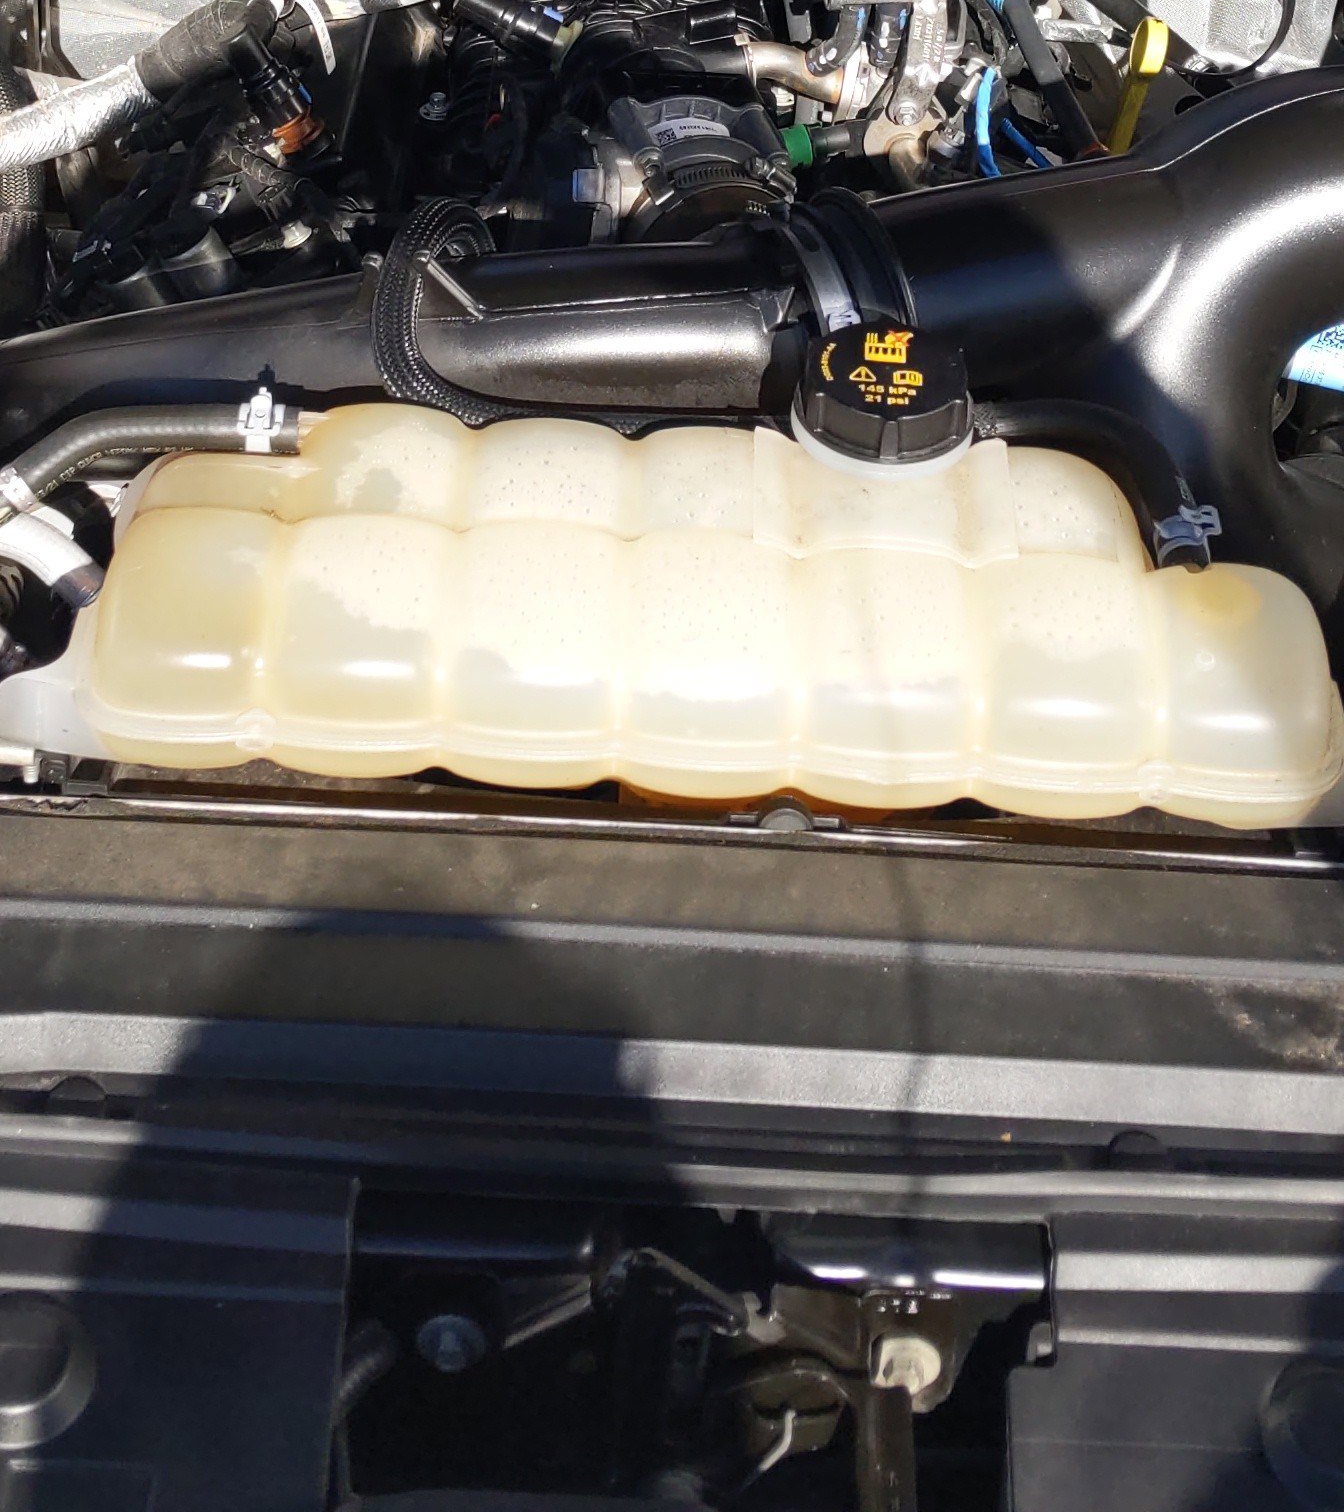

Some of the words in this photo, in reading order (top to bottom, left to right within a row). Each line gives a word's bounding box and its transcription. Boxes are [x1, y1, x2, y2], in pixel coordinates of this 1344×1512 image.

[888, 386, 917, 396] kPa
[864, 394, 882, 403] 21
[887, 397, 909, 405] psi
